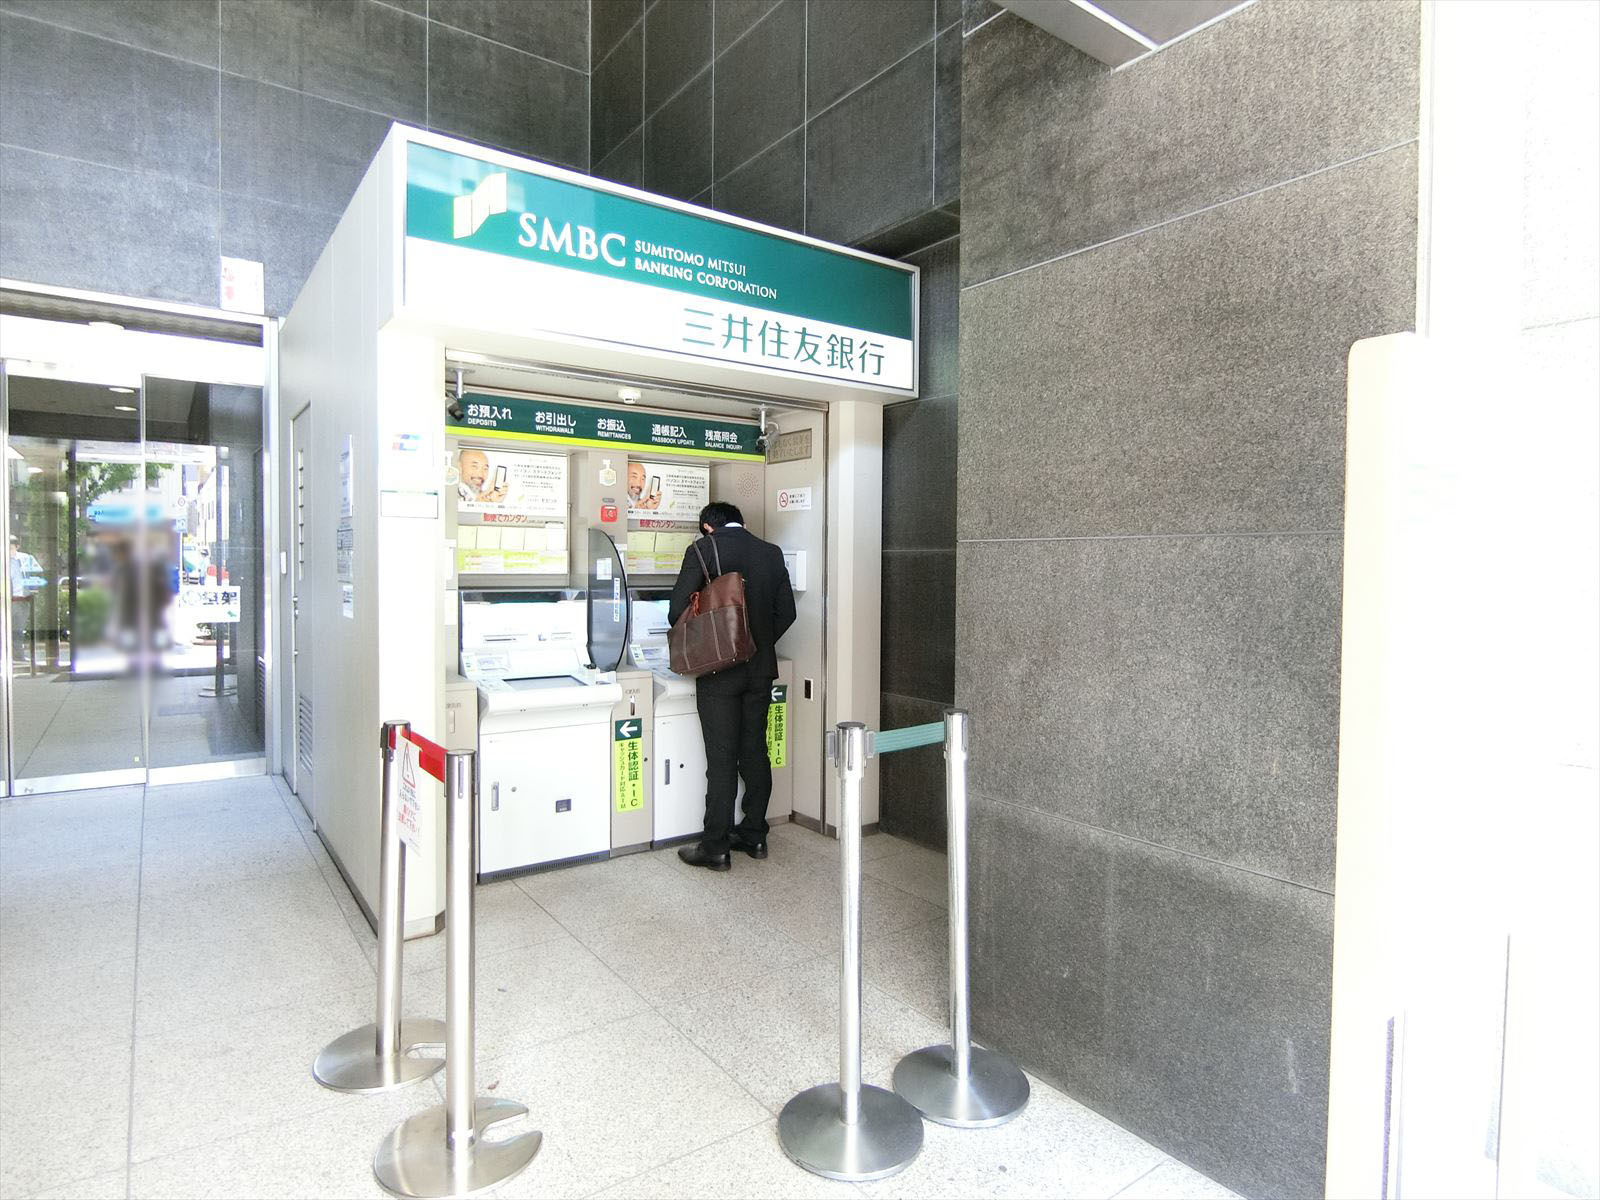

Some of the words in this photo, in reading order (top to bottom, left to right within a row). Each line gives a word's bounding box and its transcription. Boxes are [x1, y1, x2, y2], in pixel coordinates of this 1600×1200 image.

[518, 212, 626, 267] SMBC
[634, 239, 704, 267] SUMITOMO
[707, 257, 746, 277] MITSUI
[634, 257, 693, 282] BANKING
[696, 271, 777, 300] CORPORATION
[682, 307, 885, 376] 三井住友銀行
[467, 403, 513, 420] お預入れ
[535, 411, 577, 427] お引出し
[467, 418, 497, 427] DEPOSITS
[535, 424, 574, 435] WITHDRAWALS
[597, 418, 626, 432] お振込
[597, 431, 632, 440] REMITTANCES
[651, 423, 688, 439] 通帳記入
[704, 429, 738, 444] 残高照会
[651, 436, 677, 445] PASSBOOK
[677, 438, 695, 446] UPDATE
[704, 441, 725, 450] BALANCE
[628, 741, 639, 807] 生体認証・IC
